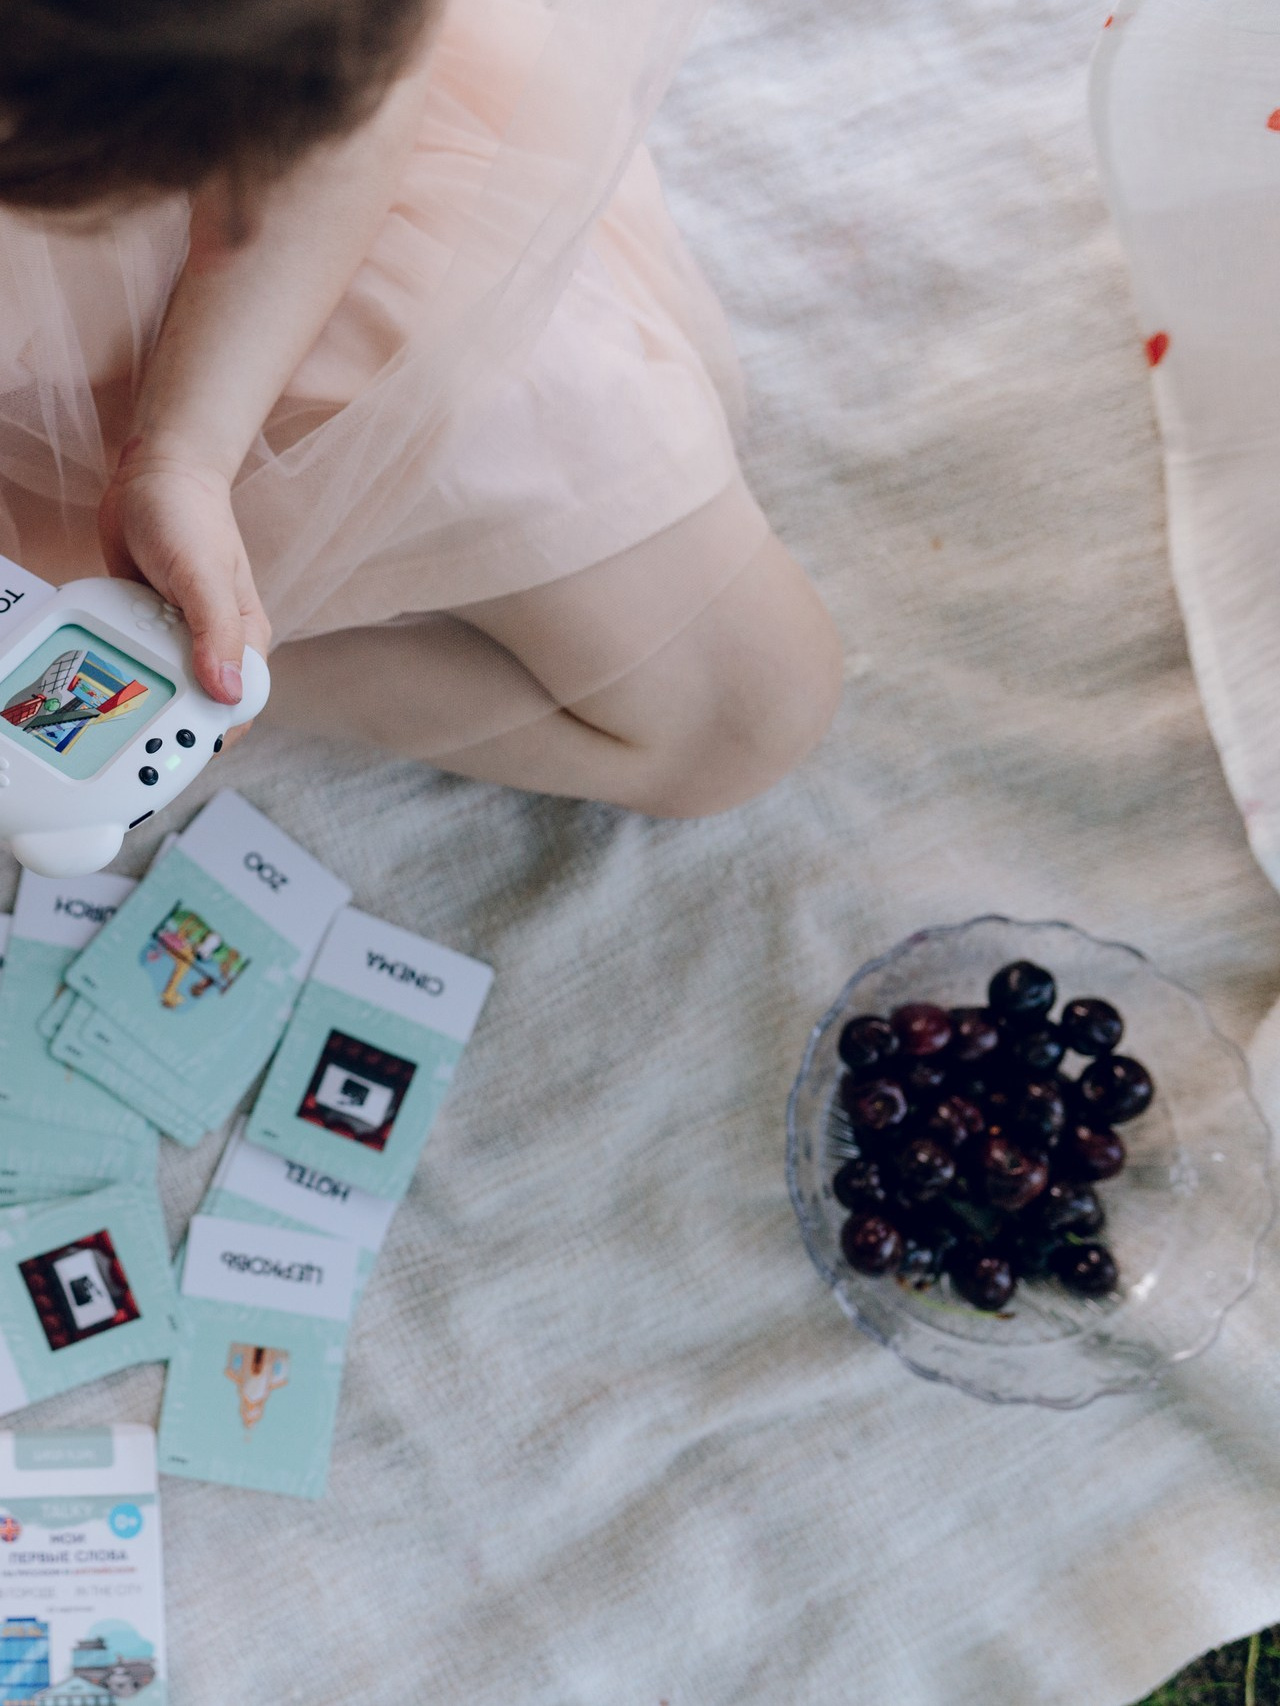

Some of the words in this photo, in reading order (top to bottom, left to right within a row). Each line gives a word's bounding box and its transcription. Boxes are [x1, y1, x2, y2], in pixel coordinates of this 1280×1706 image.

[243, 851, 289, 893] ZOO
[54, 896, 117, 925] URCH
[366, 950, 444, 996] CINEMA
[285, 1160, 351, 1203] HOTEL
[220, 1251, 324, 1284] ЦЕРКОВЬ
[74, 1549, 128, 1562] СЛОВА
